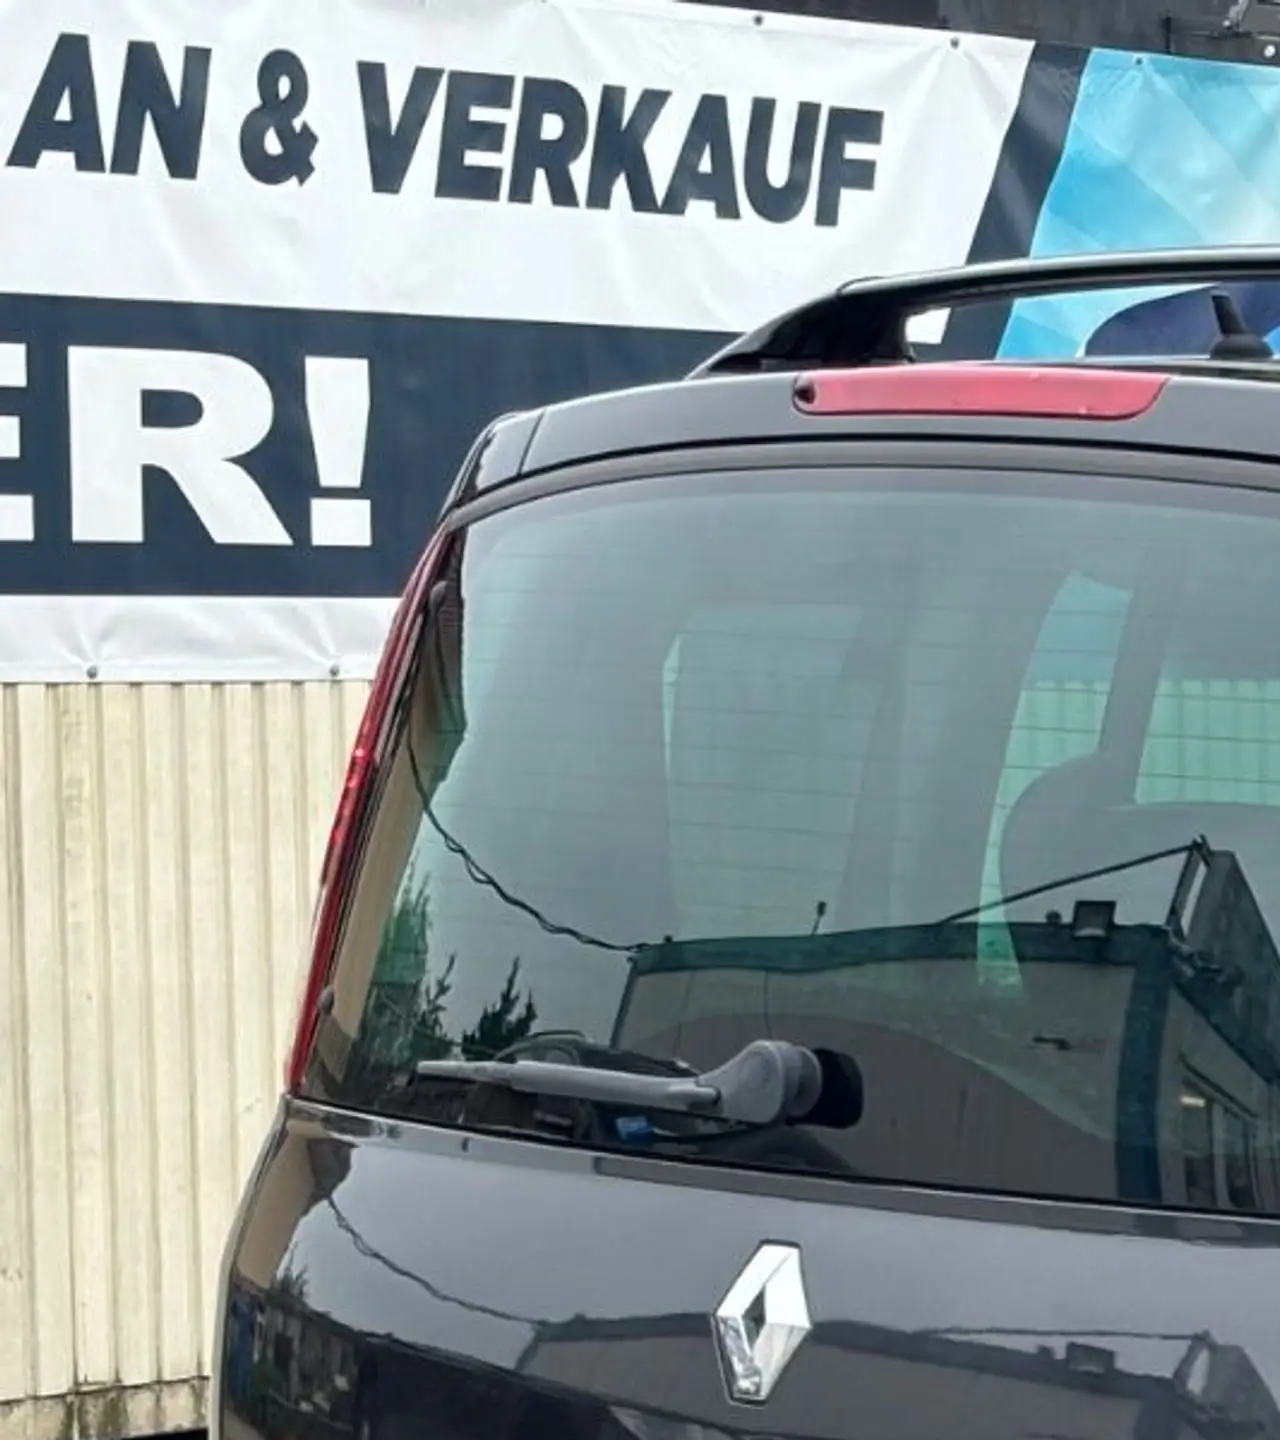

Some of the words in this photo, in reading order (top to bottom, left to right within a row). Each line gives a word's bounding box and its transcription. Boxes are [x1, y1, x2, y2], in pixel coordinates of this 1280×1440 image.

[7, 32, 211, 181] AN
[238, 49, 319, 187] &
[356, 60, 884, 227] VERKAUF
[0, 343, 371, 547] R!
